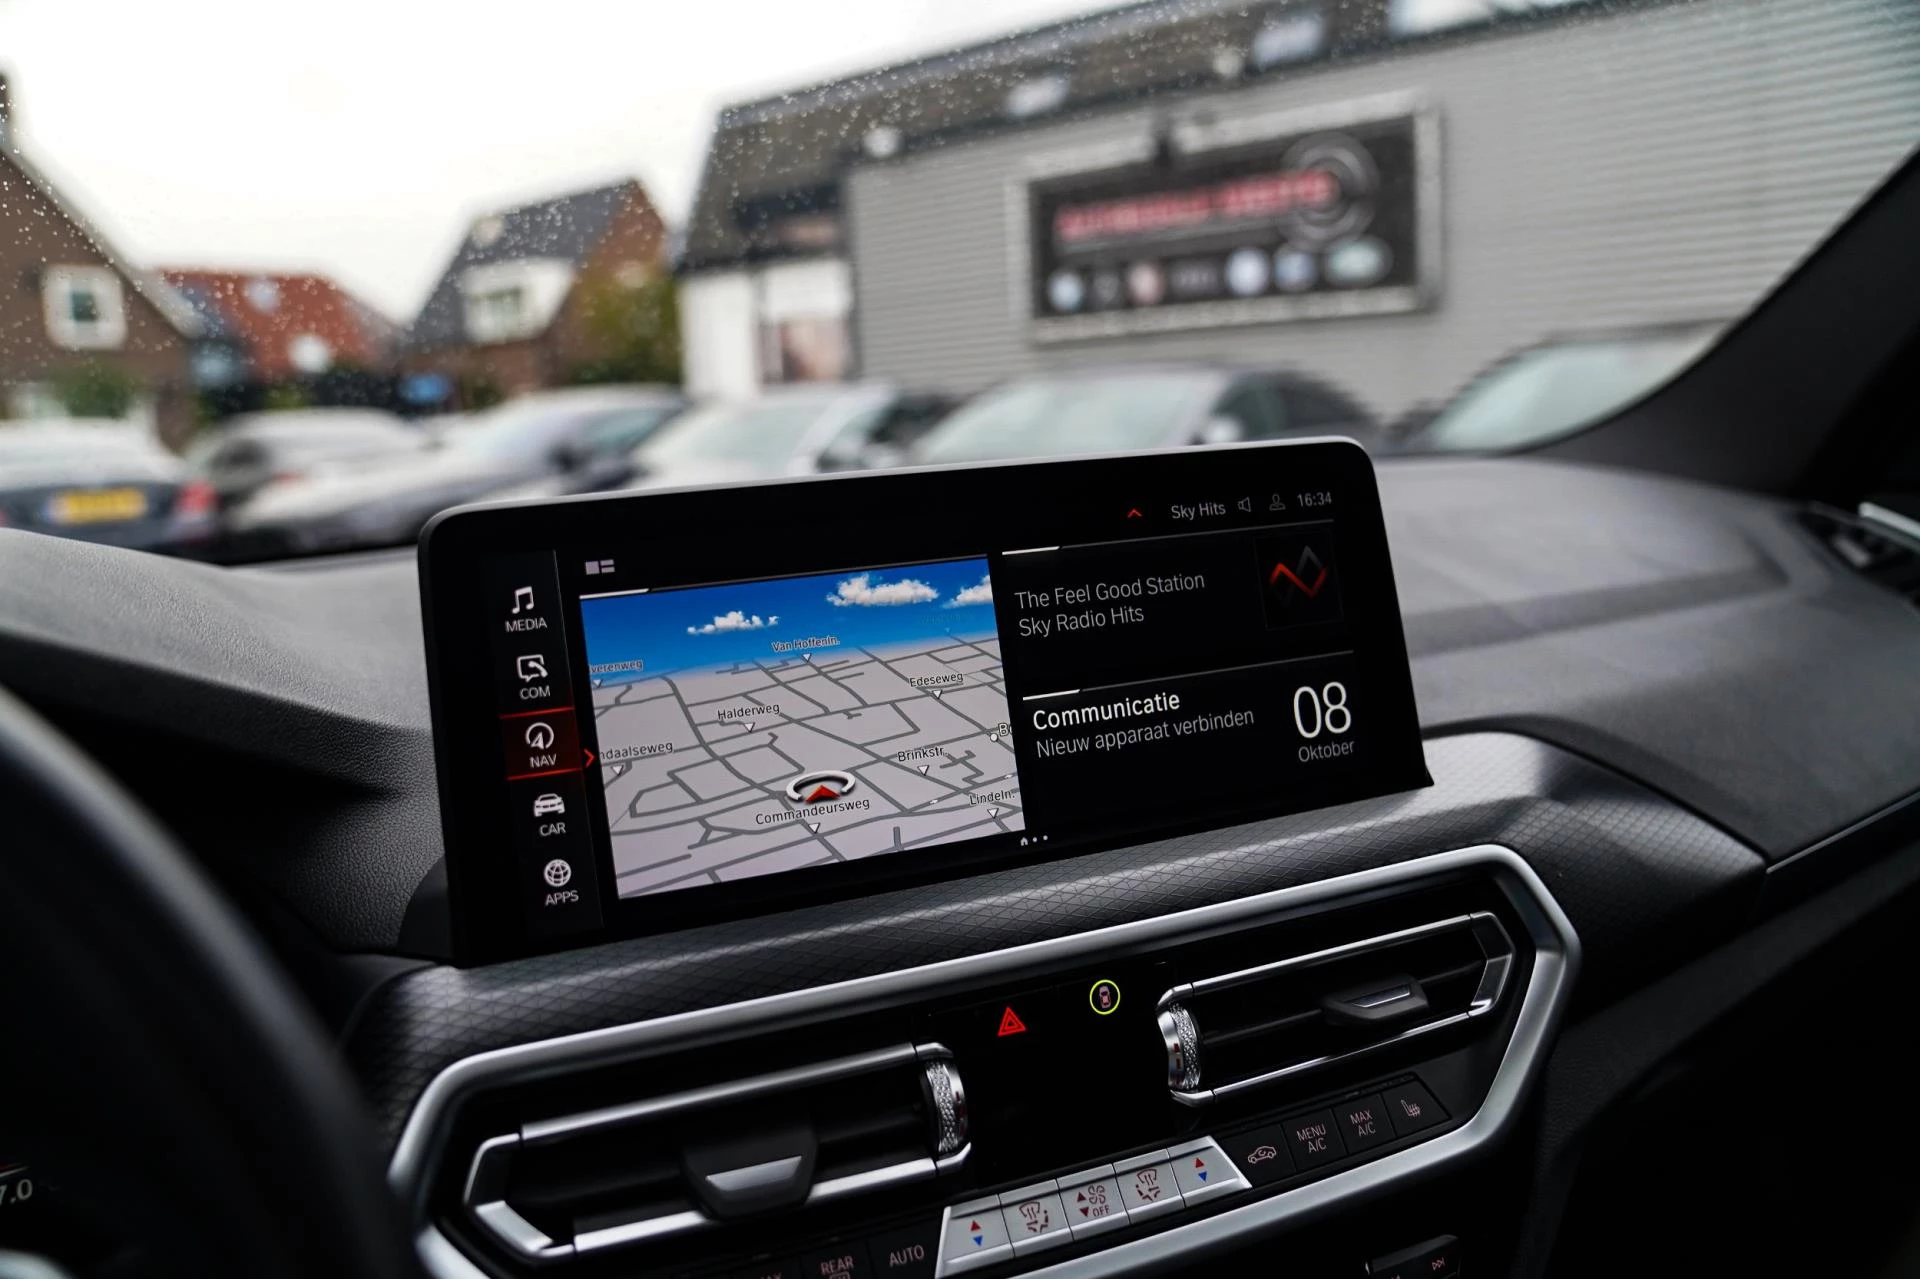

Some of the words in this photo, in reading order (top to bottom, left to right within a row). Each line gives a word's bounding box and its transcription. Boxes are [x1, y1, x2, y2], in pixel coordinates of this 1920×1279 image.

[1297, 491, 1332, 507] 16:34
[1171, 503, 1195, 520] Sky
[1199, 501, 1226, 516] Hits
[1014, 590, 1050, 609] The
[1054, 584, 1091, 605] Feel
[1095, 579, 1142, 601] Good
[1146, 572, 1205, 595] Station
[505, 617, 547, 633] MEDIA
[1019, 615, 1051, 637] Sky
[1056, 610, 1106, 631] Radio
[1111, 604, 1144, 623] Hits
[772, 642, 792, 652] Van
[909, 672, 963, 687] Edeseweg
[520, 687, 550, 700] COM
[717, 703, 780, 720] Halderweg
[1033, 692, 1180, 730] Communicatie
[1293, 681, 1351, 739] 08
[998, 722, 1012, 737] B
[1036, 735, 1089, 758] Nieuw
[1095, 721, 1169, 751] apparaat
[1173, 709, 1254, 736] verbinden
[1298, 740, 1355, 762] Oktober
[529, 755, 557, 768] NAV
[755, 799, 870, 825] Commandeursweg
[540, 823, 566, 836] CAR
[545, 890, 579, 906] APPS
[1350, 1110, 1373, 1124] MAX
[1297, 1124, 1326, 1142] MENU
[1357, 1122, 1376, 1137] A/C
[1308, 1137, 1327, 1153] A/C
[1093, 1204, 1110, 1217] OFF
[889, 1245, 924, 1268] AUTO
[820, 1256, 854, 1276] REAR
